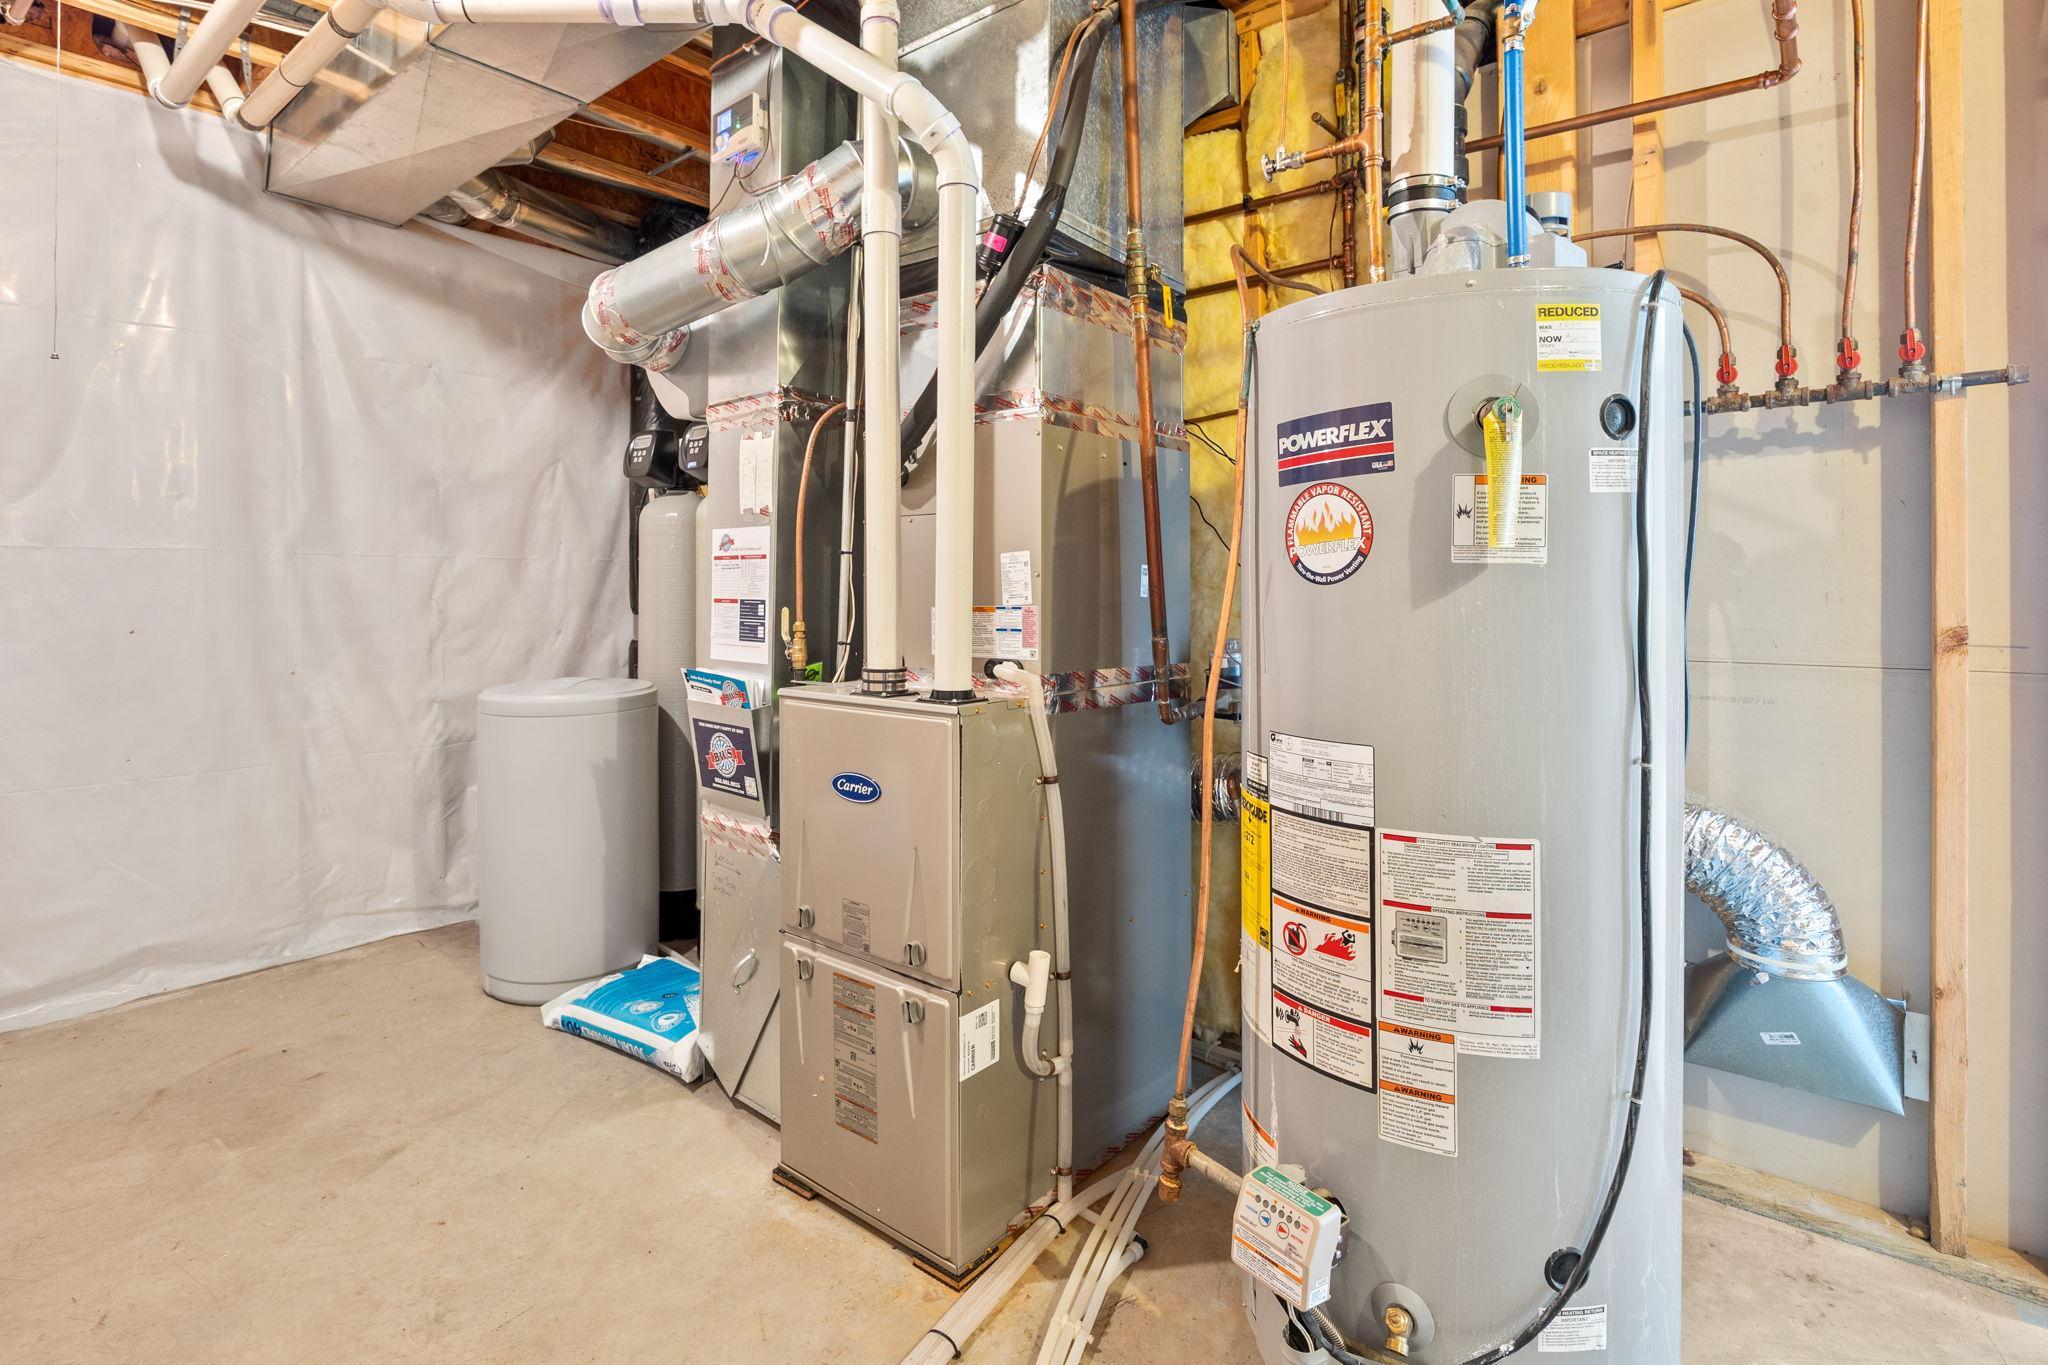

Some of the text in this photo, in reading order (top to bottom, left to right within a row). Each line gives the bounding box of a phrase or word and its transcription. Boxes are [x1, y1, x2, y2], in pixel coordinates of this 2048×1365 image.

[1537, 306, 1599, 317] REDUCED
[1538, 335, 1562, 343] NOW
[1278, 418, 1388, 455] POWERFLEX
[1287, 485, 1372, 546] FLAMMABLE VAPOR RESISTANT
[1289, 536, 1367, 559] POWERFLEX
[1327, 572, 1345, 583] Power
[1344, 556, 1364, 575] Venting
[837, 778, 873, 796] Carrier
[1300, 908, 1331, 923] WARNING
[1303, 1006, 1331, 1023] DANGER
[1400, 1027, 1442, 1041] WARNING
[1400, 1086, 1442, 1101] WARNING
